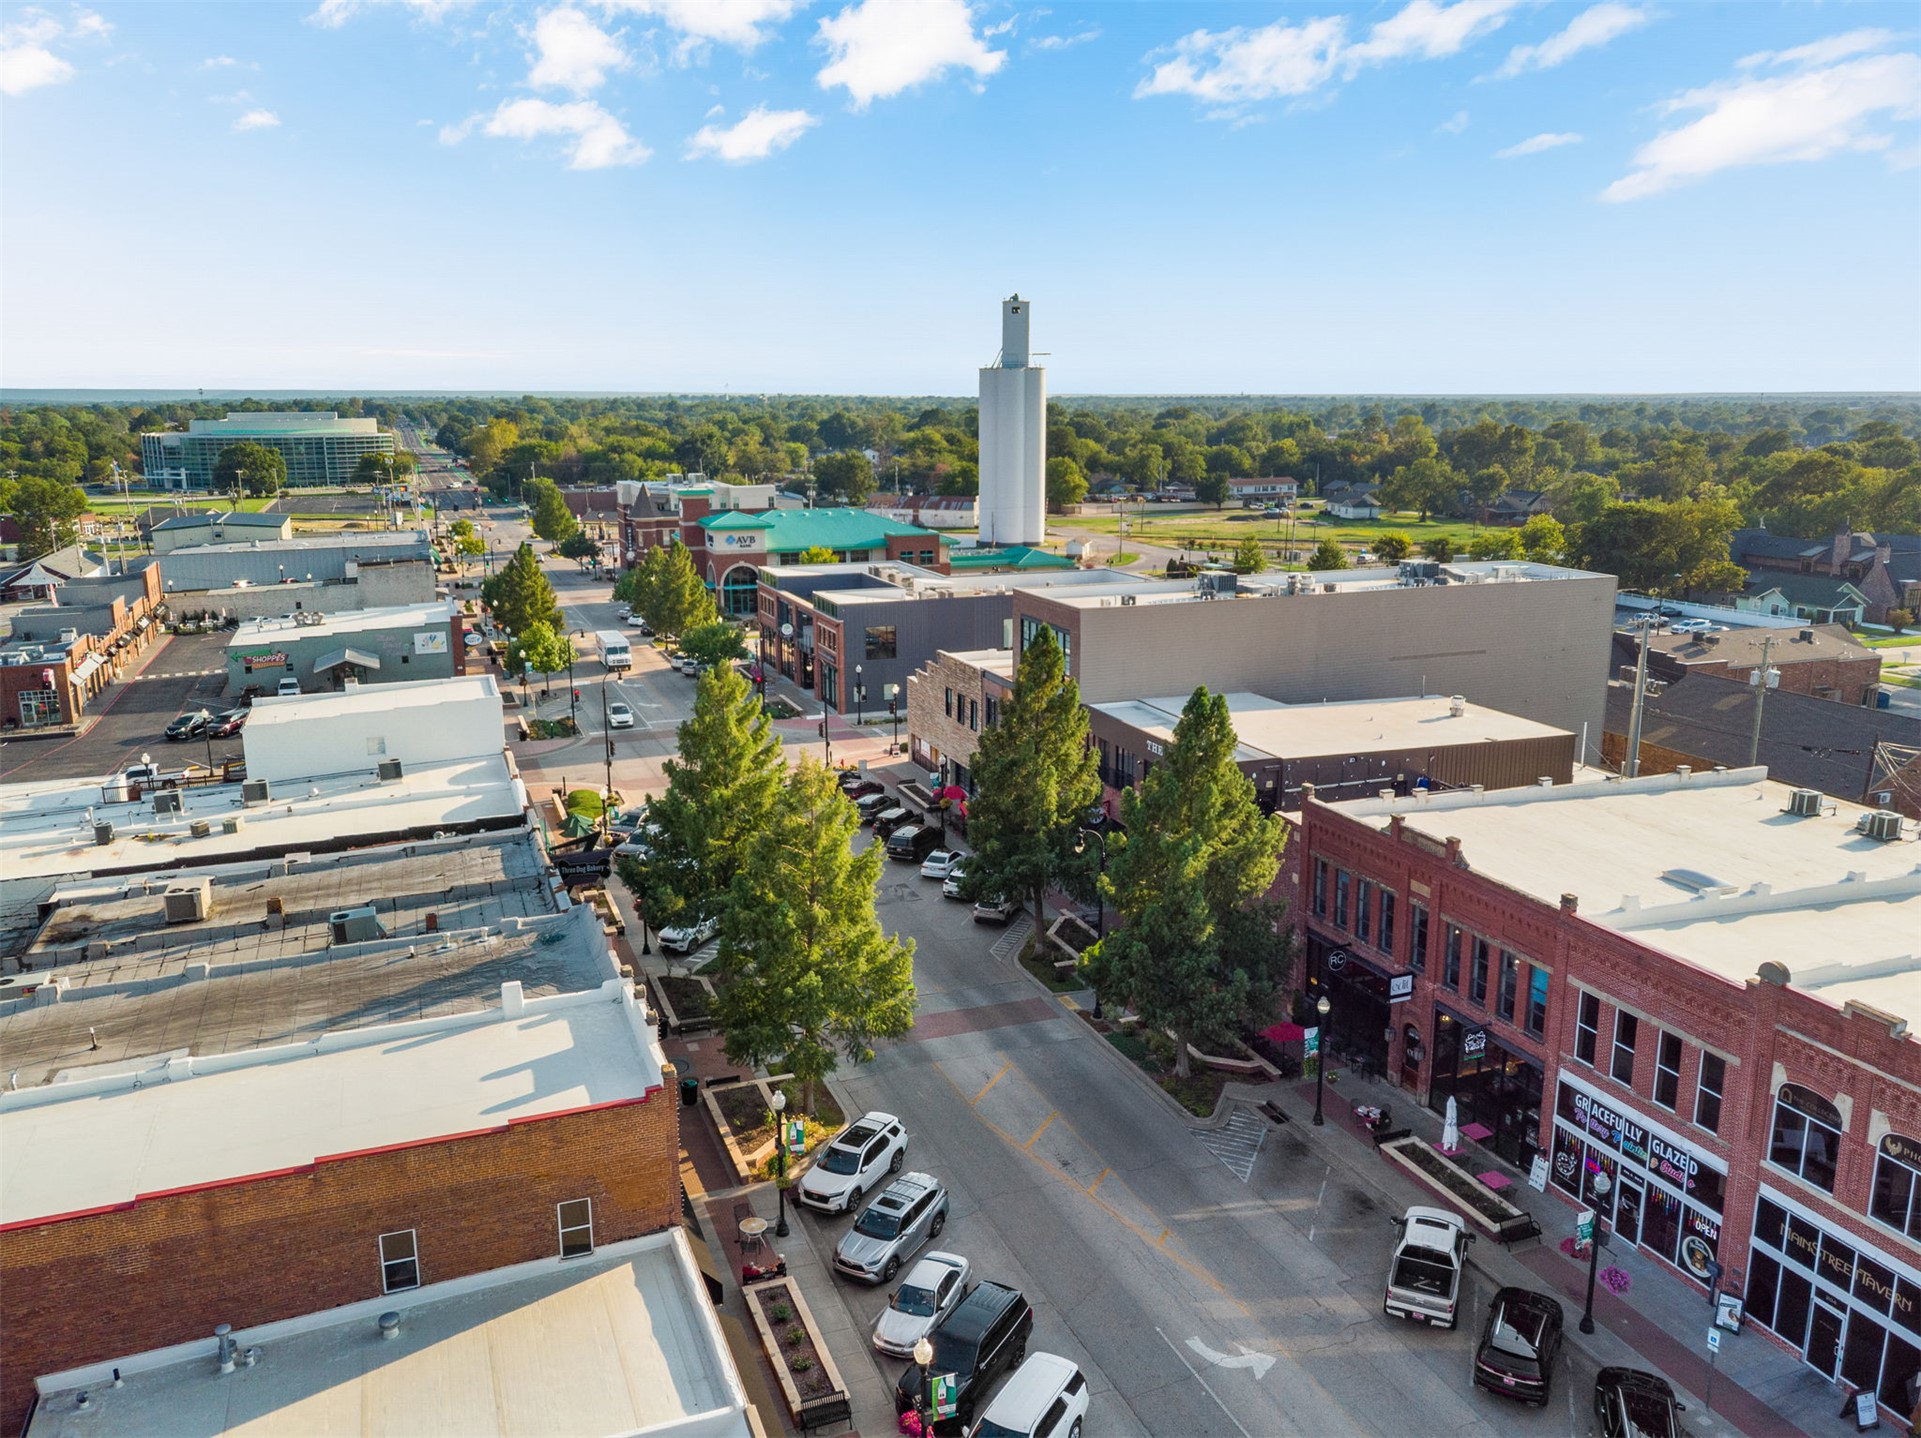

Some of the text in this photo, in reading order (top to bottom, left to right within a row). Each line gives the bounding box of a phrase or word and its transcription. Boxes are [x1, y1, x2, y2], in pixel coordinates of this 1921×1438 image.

[736, 535, 756, 545] AVB
[252, 654, 286, 663] SHOPPES
[1146, 739, 1164, 757] THE
[576, 865, 586, 874] Dog
[1330, 954, 1344, 965] RC
[1575, 1094, 1698, 1176] GRACEFULLY GLAZED
[1660, 1159, 1696, 1189] Studio
[1695, 1220, 1718, 1241] OPEN
